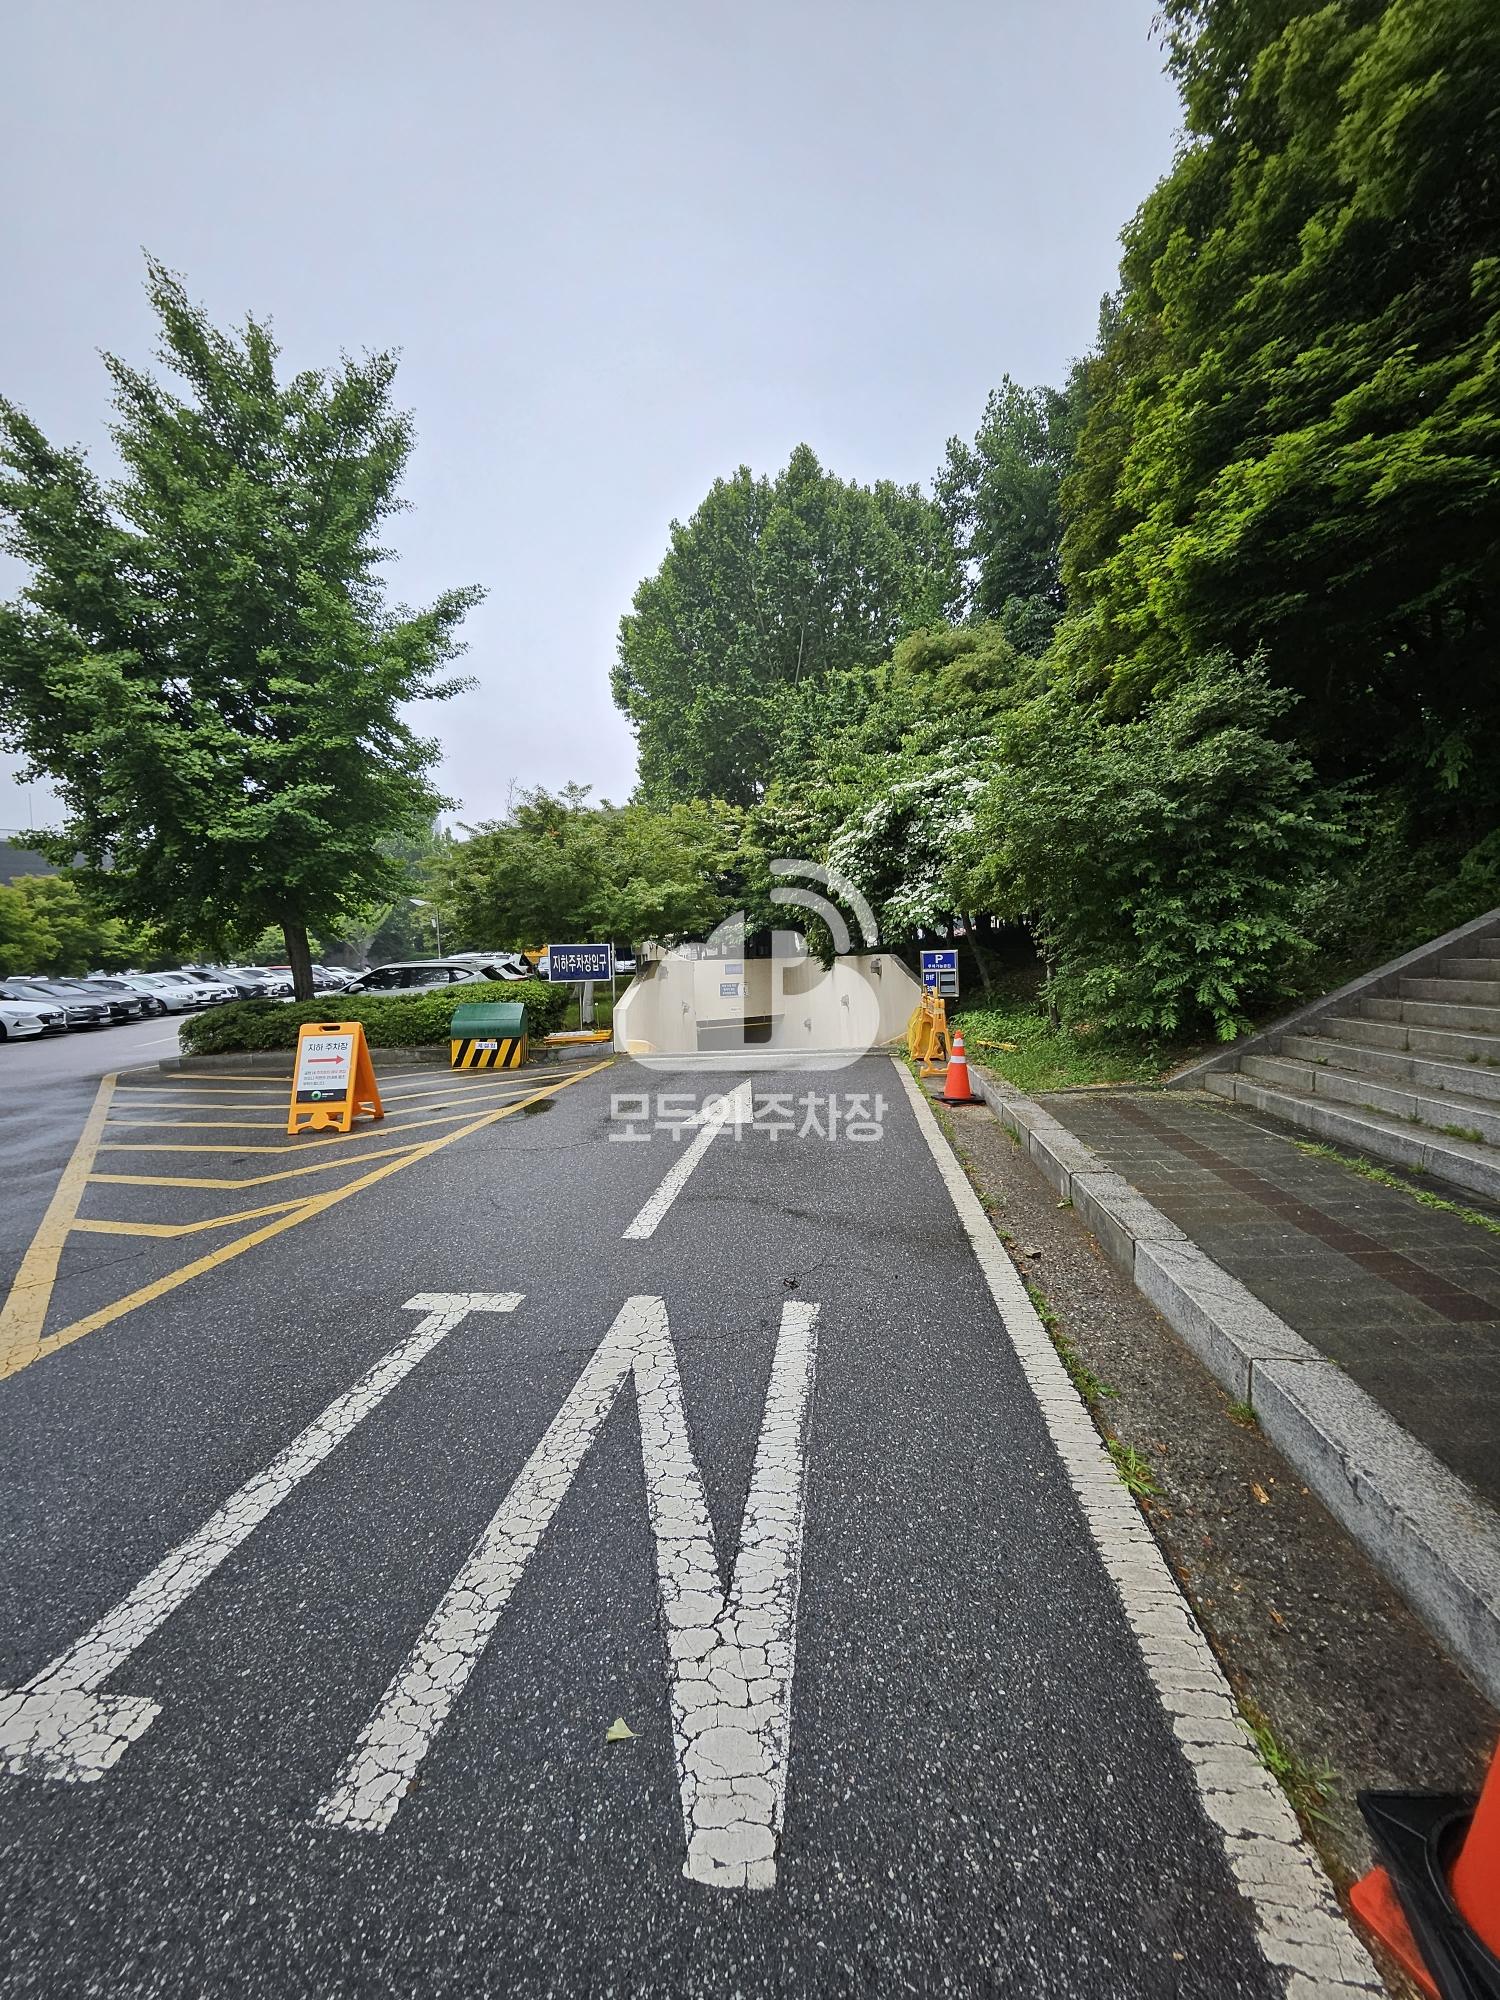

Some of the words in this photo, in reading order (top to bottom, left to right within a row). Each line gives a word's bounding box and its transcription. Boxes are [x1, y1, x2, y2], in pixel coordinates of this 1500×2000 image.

[552, 953, 607, 973] 지하주차장입구
[935, 954, 944, 964] P
[308, 1042, 324, 1052] 지하
[325, 1042, 349, 1051] 주차장
[0, 1291, 822, 1891] IN
